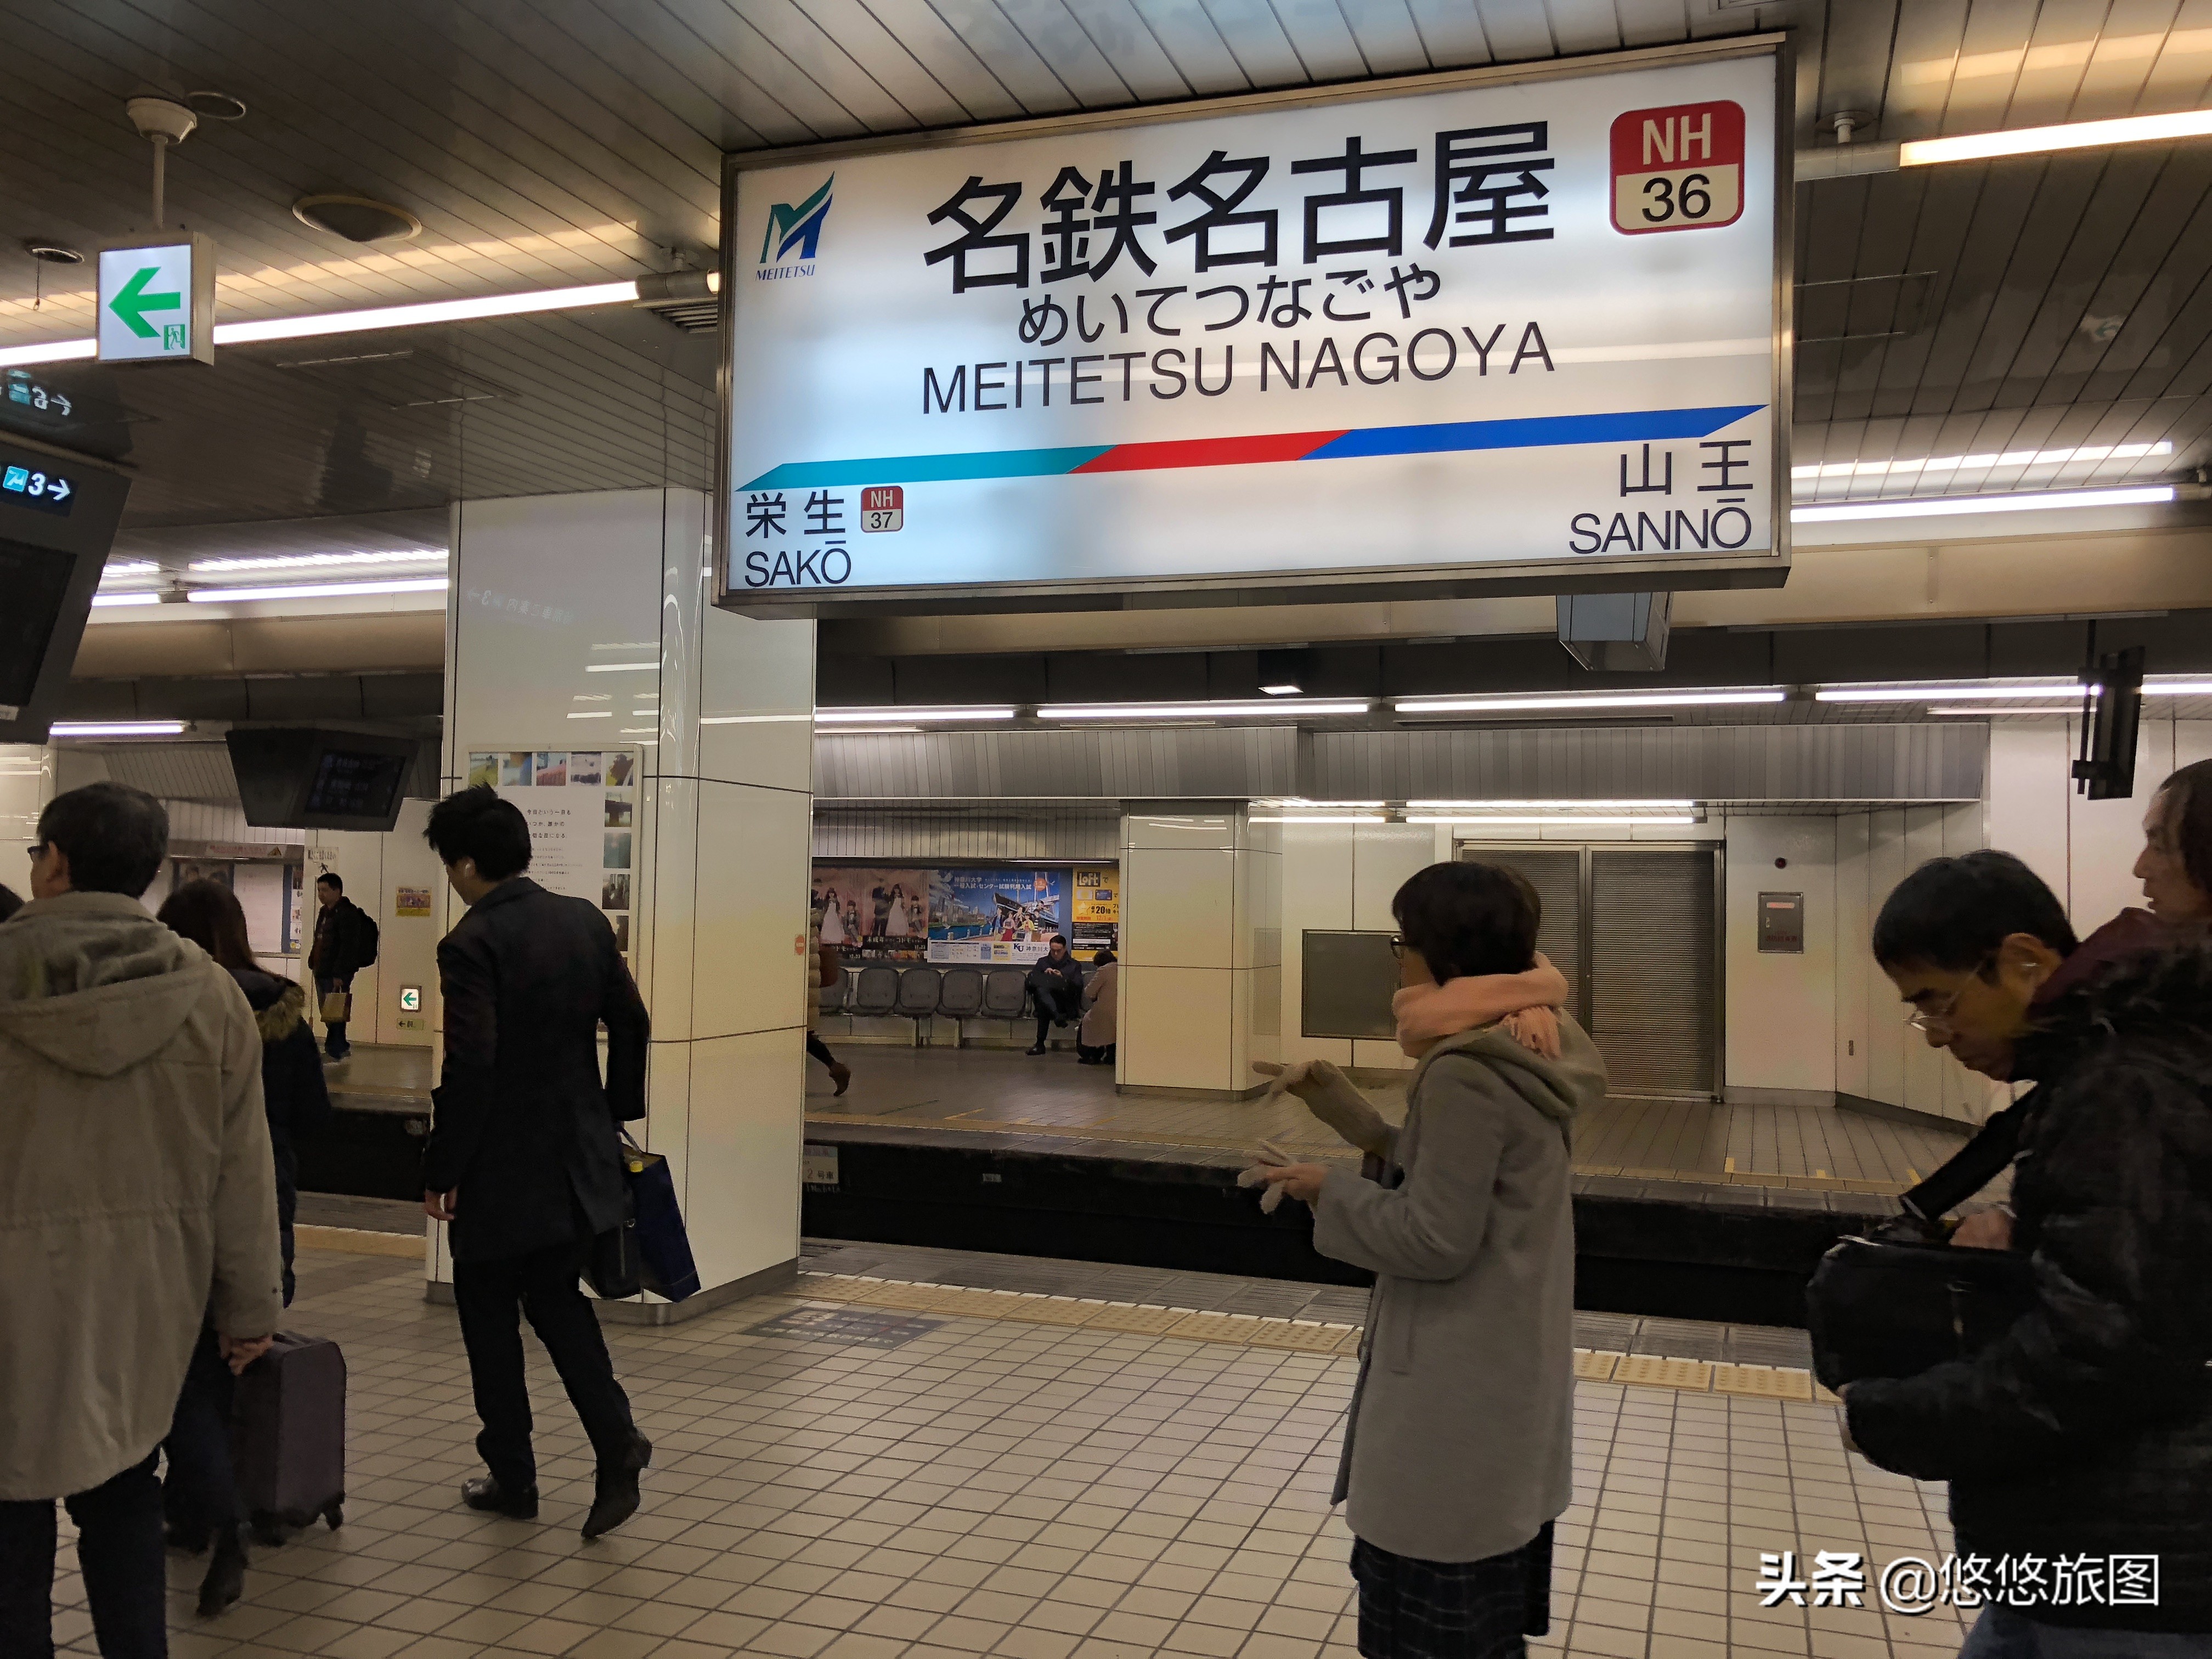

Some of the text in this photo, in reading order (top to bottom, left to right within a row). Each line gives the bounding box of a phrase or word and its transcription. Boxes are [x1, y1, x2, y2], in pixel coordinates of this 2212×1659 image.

[1643, 112, 1711, 165] NH
[923, 120, 1555, 294] 名鉄名古屋
[1642, 173, 1711, 222] 36
[755, 264, 815, 281] MEITETSU
[1018, 262, 1441, 348] めいてつなごや
[923, 320, 1555, 415] MEITETSU NAGOYA
[28, 473, 46, 496] 3
[1620, 440, 1753, 497] 山王
[746, 489, 845, 538] 栄生
[871, 489, 893, 508] NH
[871, 512, 893, 529] 37
[1569, 498, 1751, 554] SANNŌ
[745, 540, 851, 587] SAKŌ
[1079, 872, 1098, 886] Loft
